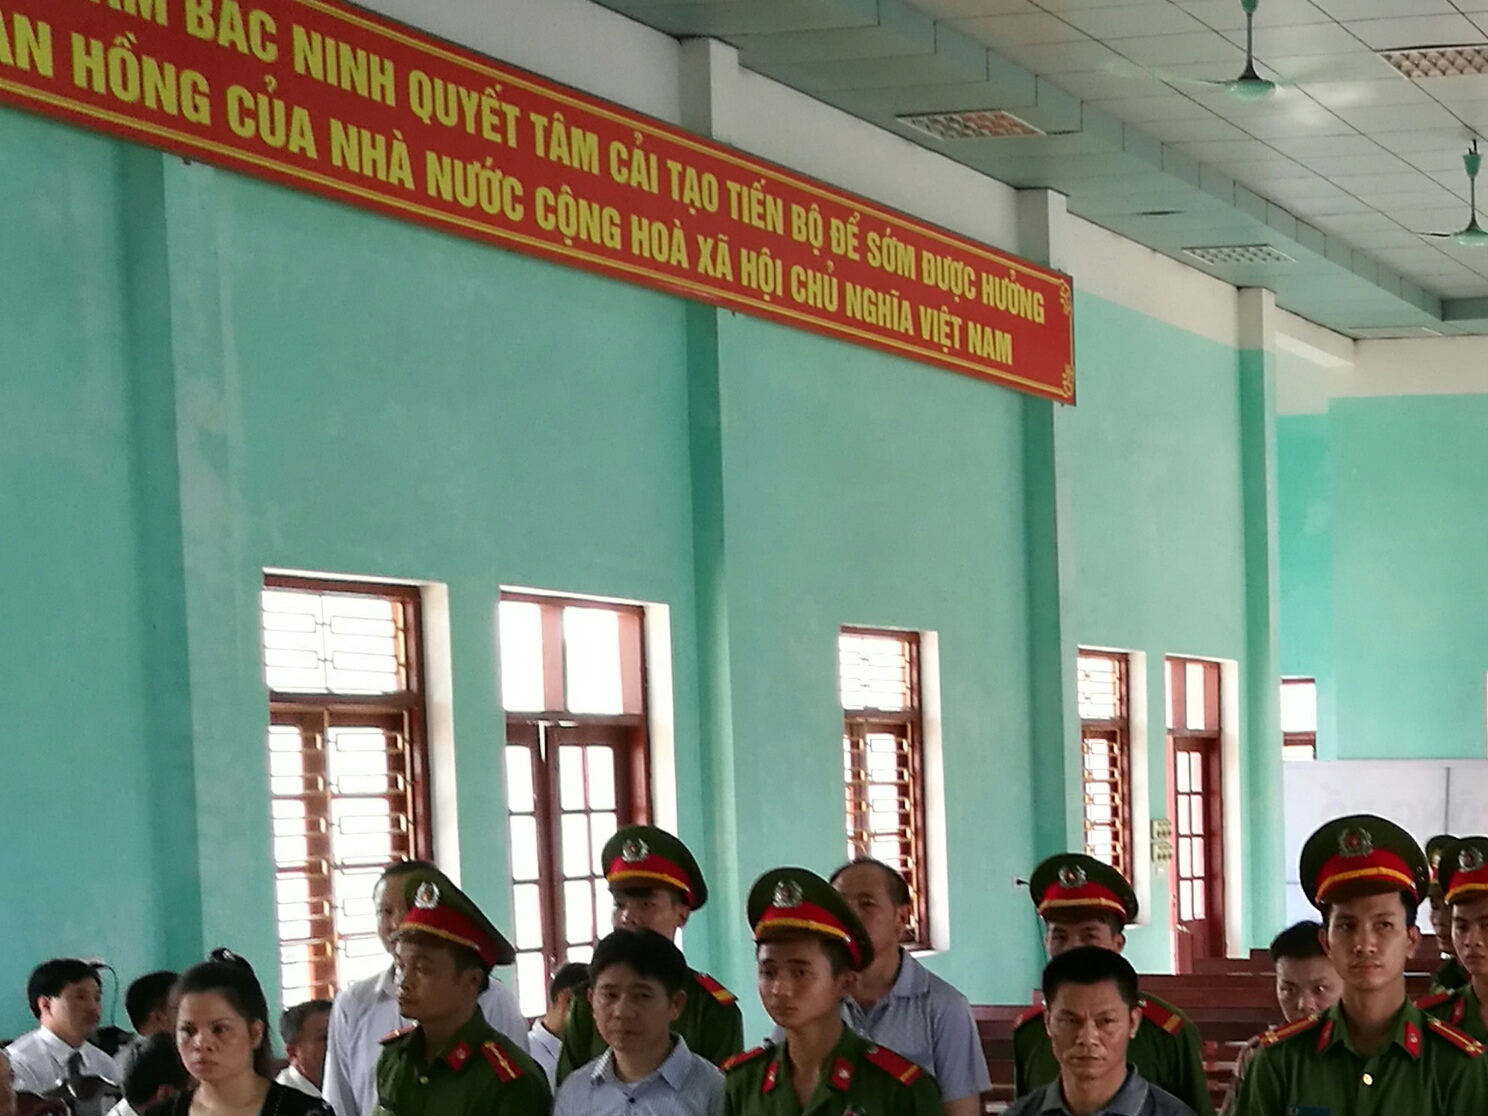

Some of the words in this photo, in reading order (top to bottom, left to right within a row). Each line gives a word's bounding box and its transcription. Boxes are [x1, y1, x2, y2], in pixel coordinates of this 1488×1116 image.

[71, 31, 211, 126] HỒNG
[226, 74, 318, 160] CỦA
[330, 118, 415, 191] NHÀ
[426, 150, 524, 222] NƯỚC
[535, 185, 622, 250] CỘNG
[630, 214, 689, 269] HOÀ
[697, 233, 734, 282] XÃ
[740, 247, 783, 301] HỘI
[790, 260, 838, 312] CHỦ
[845, 281, 914, 336] NGHĨA
[919, 304, 962, 353] VIỆT
[968, 321, 1012, 365] NAM
[292, 23, 395, 107] NINH
[408, 70, 520, 149] QUYẾT
[530, 112, 600, 176] TÂM
[609, 131, 659, 194] CẢI
[667, 159, 719, 215] TẠO
[726, 179, 783, 235] TIẾN
[791, 203, 823, 256] BỘ
[830, 211, 860, 261] ĐỂ
[866, 227, 916, 280] SỚM
[921, 250, 976, 302] ĐƯỢC
[981, 269, 1045, 324] HƯỞNG
